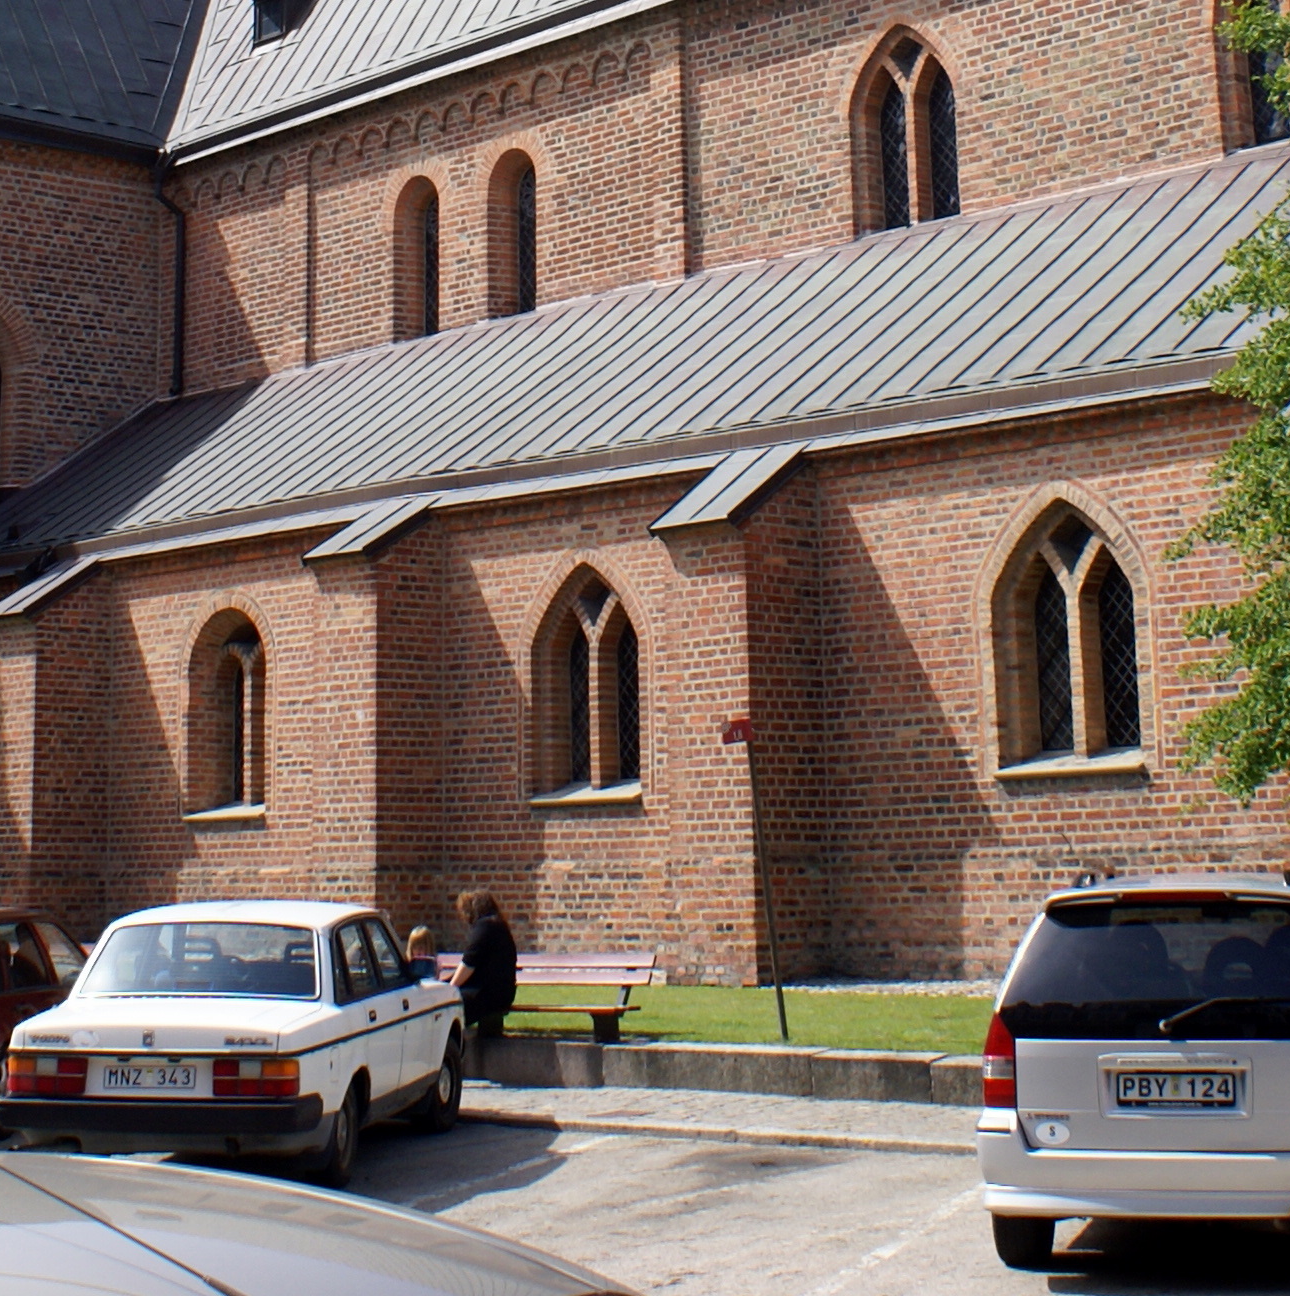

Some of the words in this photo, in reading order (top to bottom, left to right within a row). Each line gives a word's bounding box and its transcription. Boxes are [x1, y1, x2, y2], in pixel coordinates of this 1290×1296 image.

[109, 1069, 142, 1085] MNZ
[158, 1069, 191, 1085] 343
[1123, 1077, 1166, 1097] PBY
[1187, 1078, 1230, 1097] 124
[1049, 1125, 1056, 1137] S
